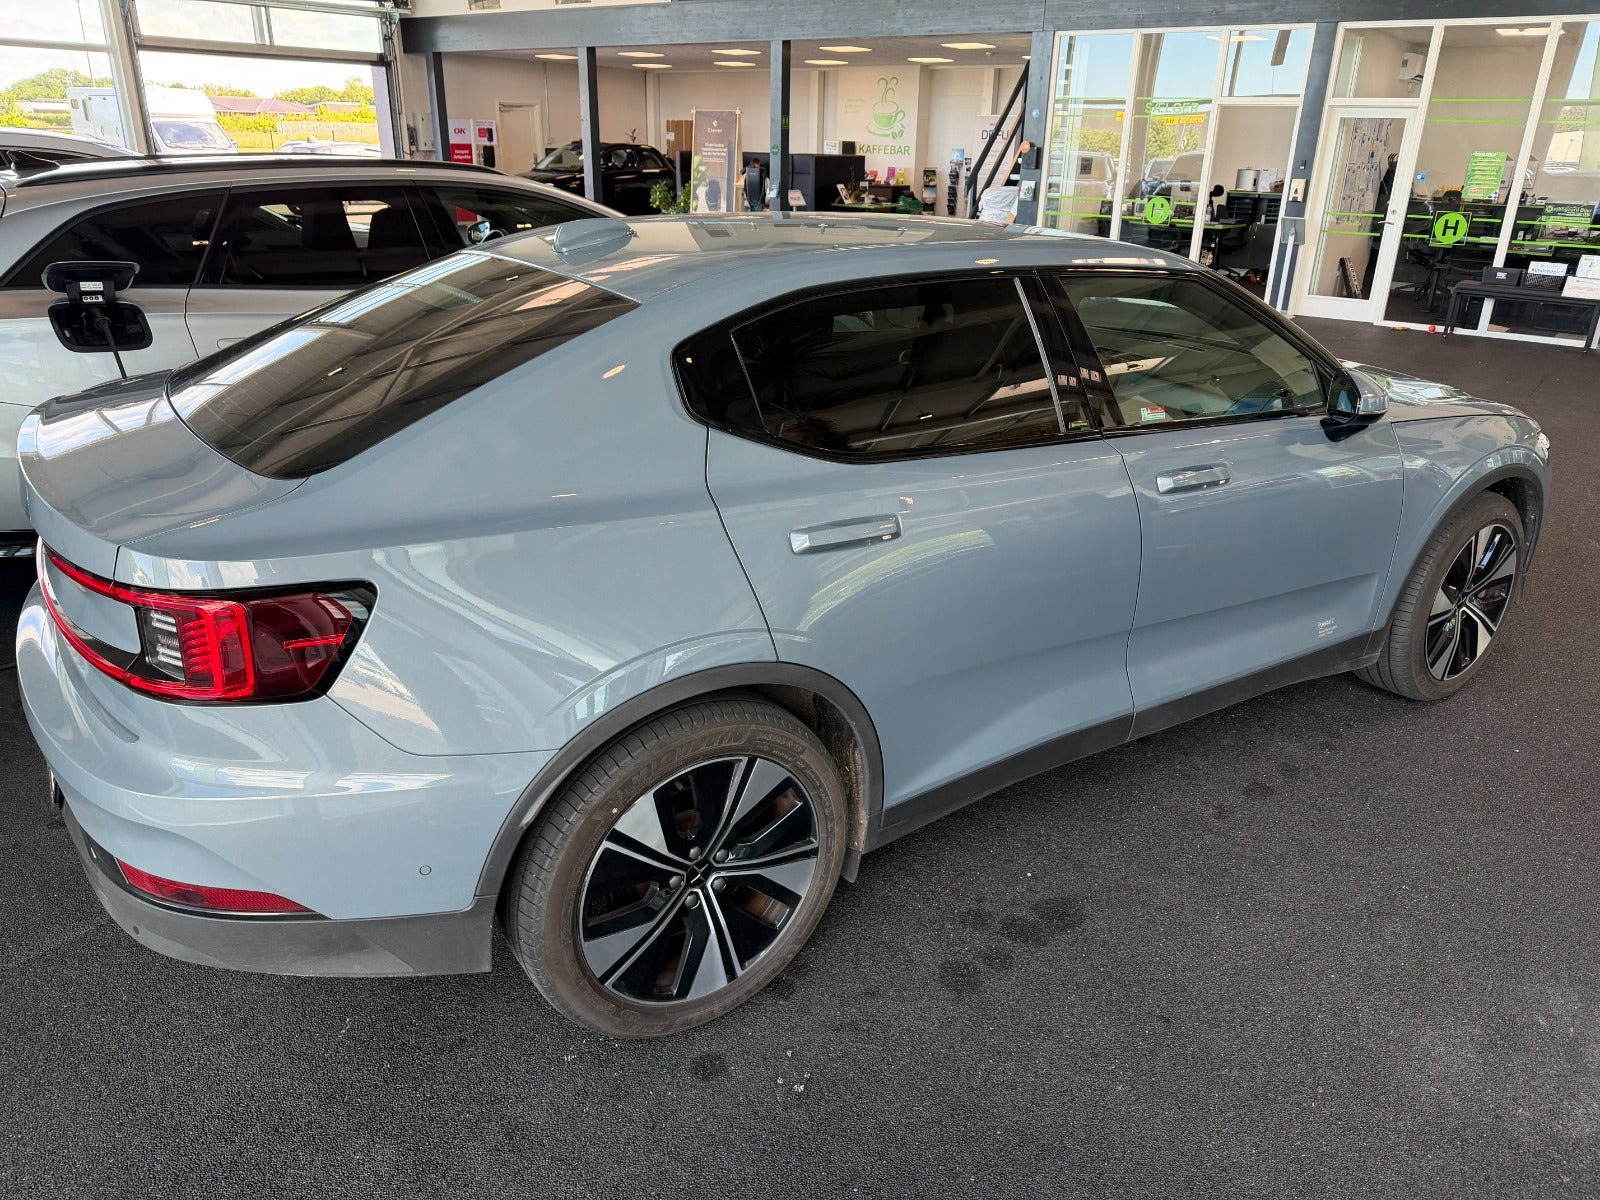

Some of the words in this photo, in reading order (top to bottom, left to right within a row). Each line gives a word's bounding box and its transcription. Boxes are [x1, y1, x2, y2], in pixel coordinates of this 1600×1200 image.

[1144, 102, 1200, 114] SÆLGER
[453, 127, 467, 135] OK
[858, 144, 911, 155] KAFFEBAR
[1151, 202, 1165, 219] H
[1441, 219, 1460, 237] H
